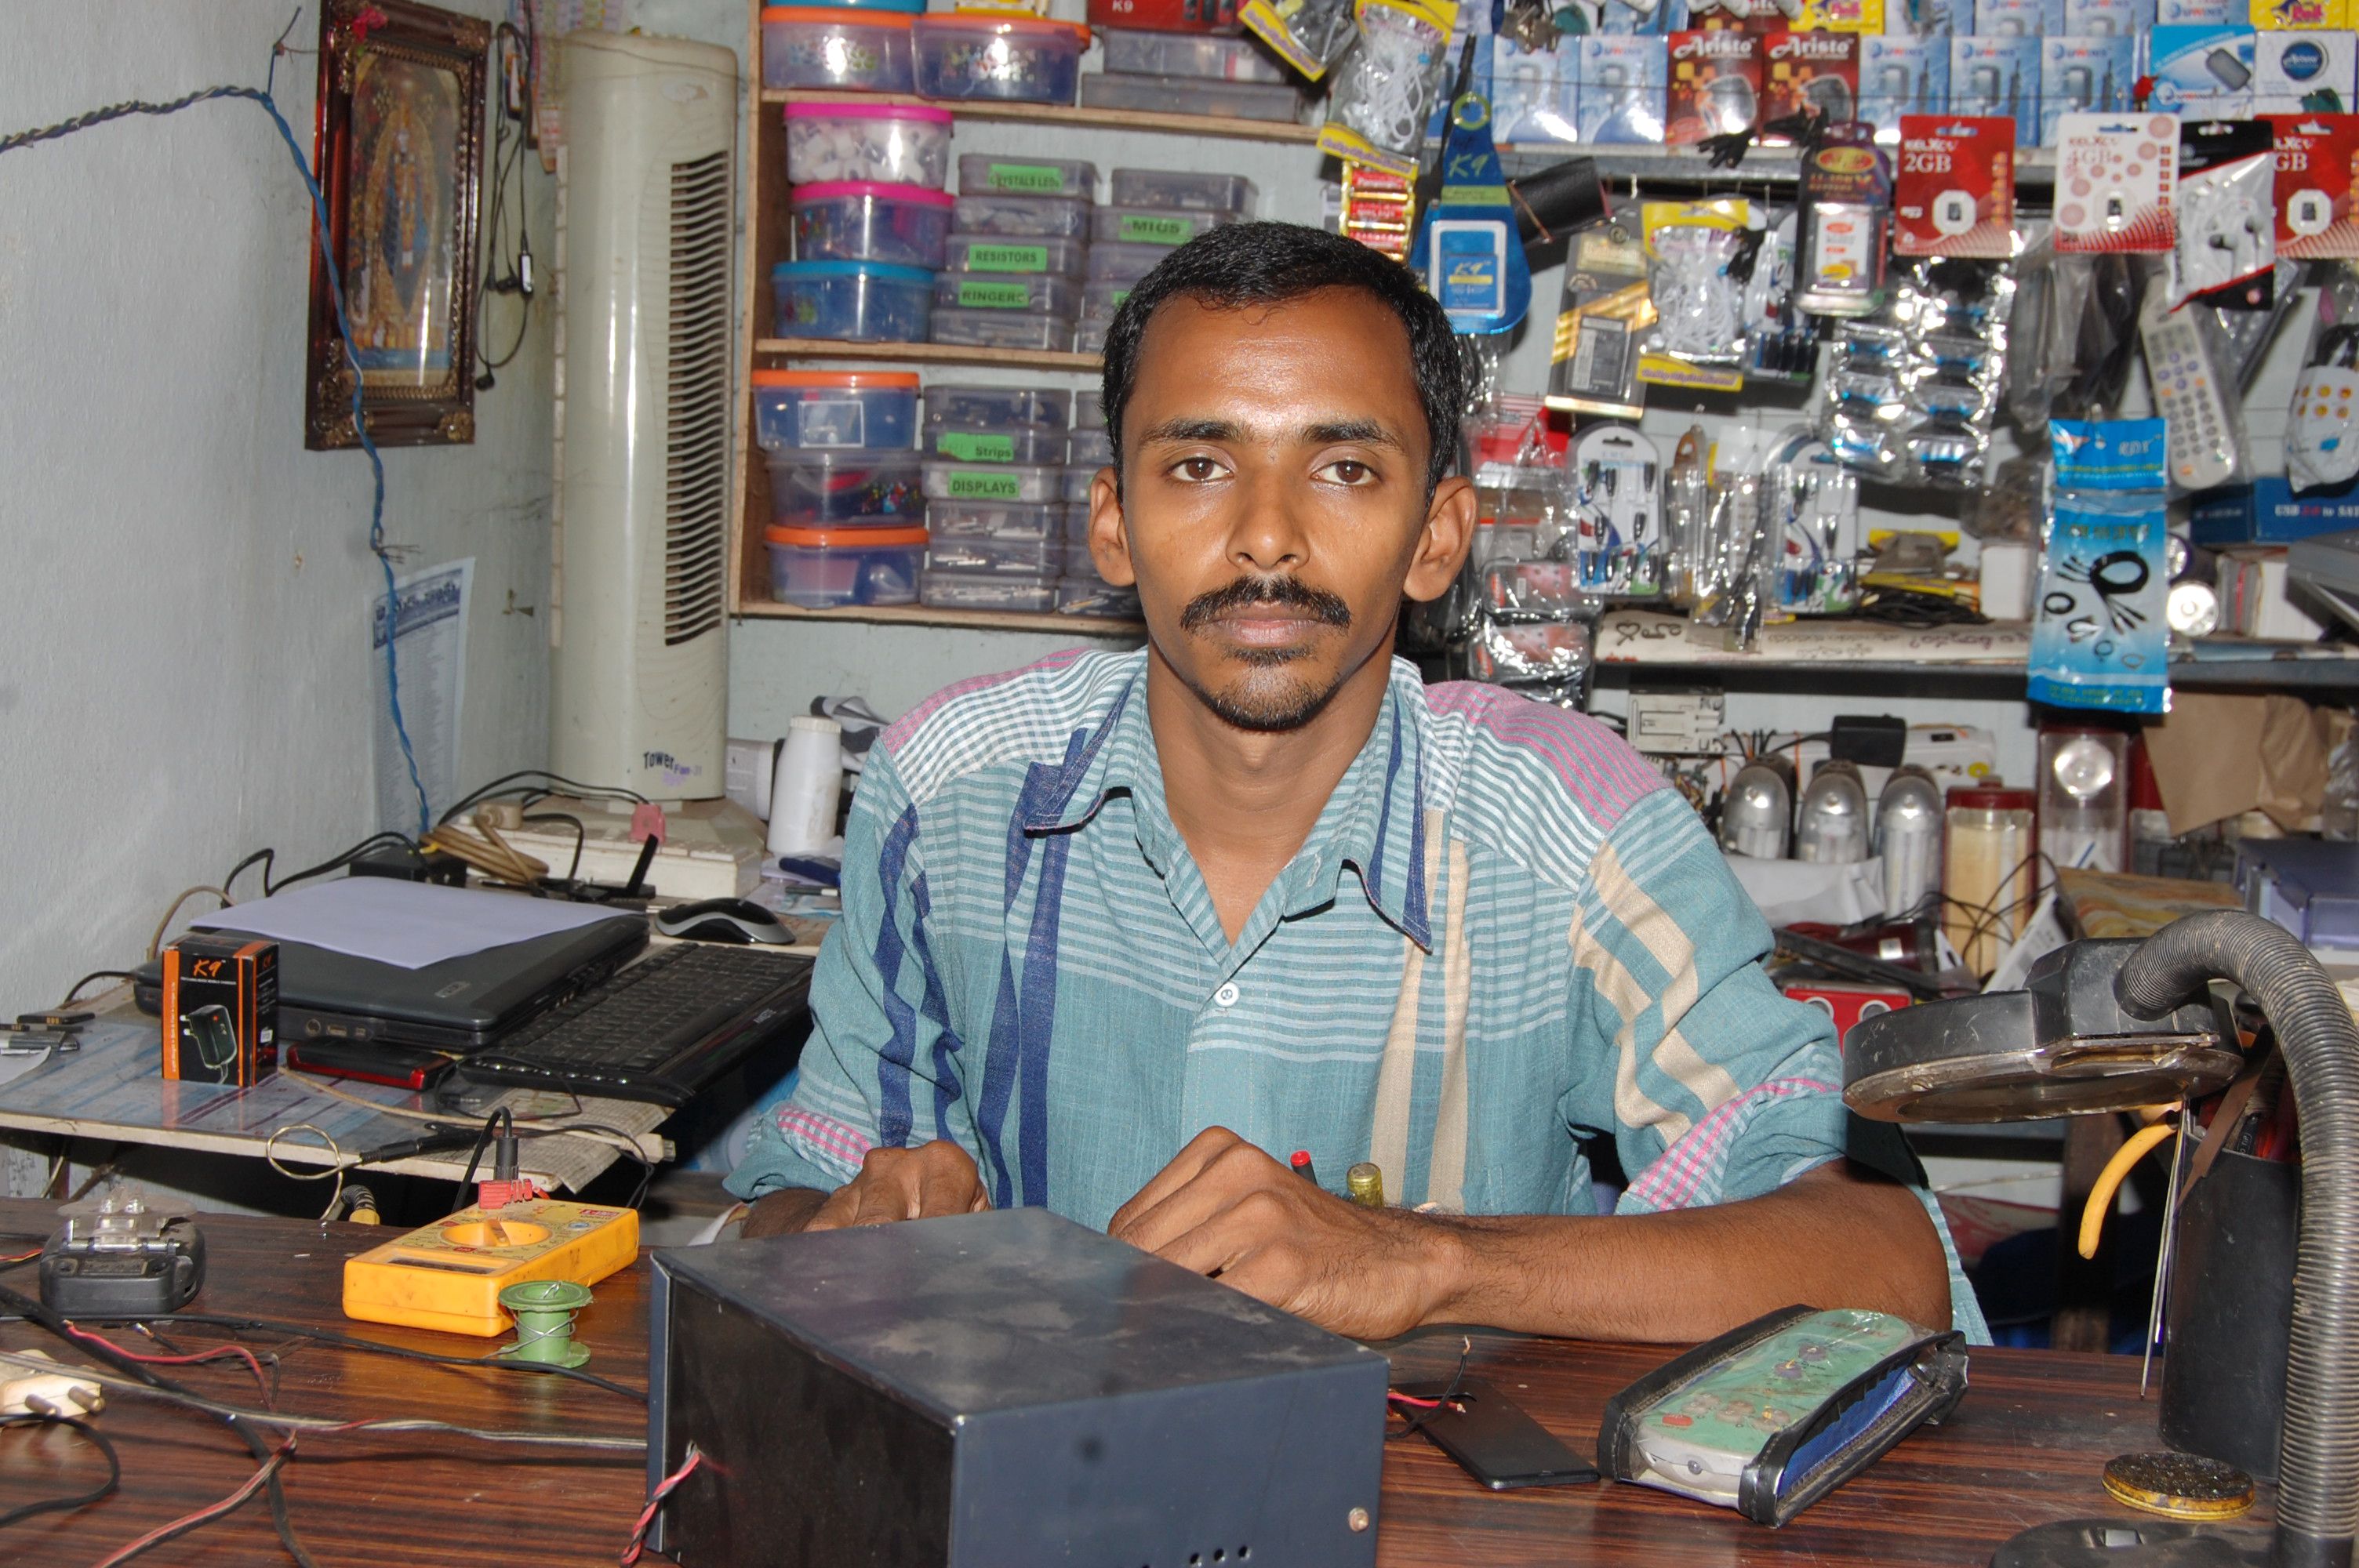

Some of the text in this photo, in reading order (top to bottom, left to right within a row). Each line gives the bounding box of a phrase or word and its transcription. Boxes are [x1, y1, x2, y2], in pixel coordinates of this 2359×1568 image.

[1673, 35, 1752, 59] Aristo
[1769, 35, 1849, 59] Aristo
[1448, 153, 1489, 179] K9
[1904, 152, 1952, 173] 2GB
[2273, 152, 2309, 172] GB
[976, 249, 1037, 263] RESISTORS
[976, 445, 1011, 459] Strips
[952, 480, 1017, 494] DISPLAYS
[643, 750, 674, 771] Tower
[193, 959, 222, 978] K9
